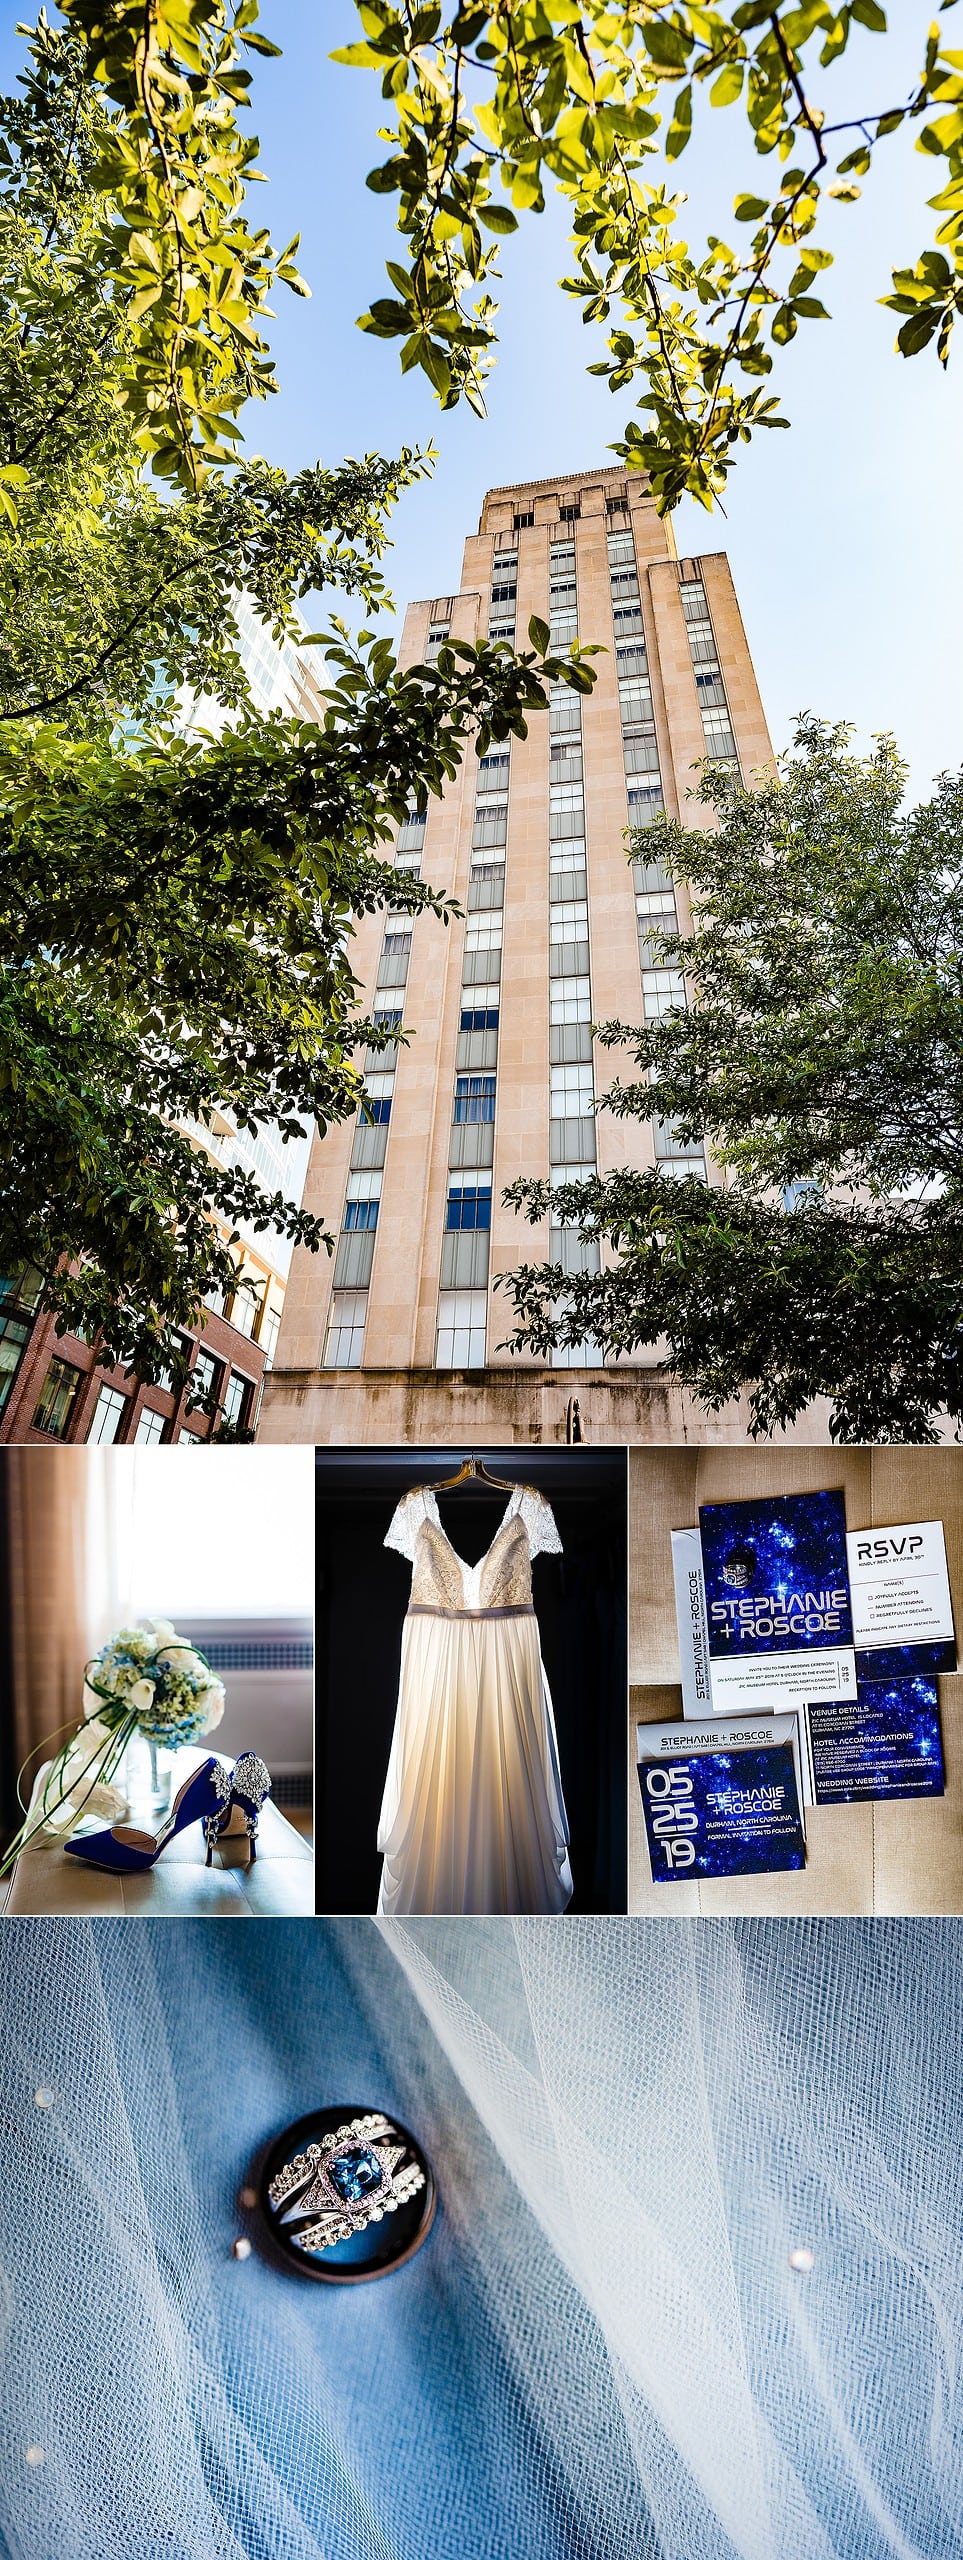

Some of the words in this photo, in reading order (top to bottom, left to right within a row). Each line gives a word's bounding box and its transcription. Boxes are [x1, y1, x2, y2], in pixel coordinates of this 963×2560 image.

[857, 1536, 923, 1560] RSVP
[688, 1571, 700, 1620] ROSCOE
[711, 1590, 848, 1620] STEPHANIE
[720, 1623, 734, 1638] +
[740, 1612, 841, 1638] ROSCOE
[692, 1632, 705, 1699] STEPHANIE
[811, 1708, 837, 1716] VENUE
[838, 1706, 869, 1714] DETAILS
[661, 1734, 718, 1746] STEPHANIE
[730, 1730, 772, 1741] ROSCOE
[839, 1732, 914, 1744] ACCOMMODATIONS
[646, 1766, 693, 1798] 05
[817, 1779, 853, 1787] WEDDING
[855, 1776, 889, 1785] WEBSITE
[706, 1786, 785, 1805] STEPHANIE
[724, 1799, 782, 1815] ROSCOE
[651, 1802, 698, 1834] 25
[760, 1814, 792, 1823] CAROLINA
[660, 1839, 696, 1868] 19
